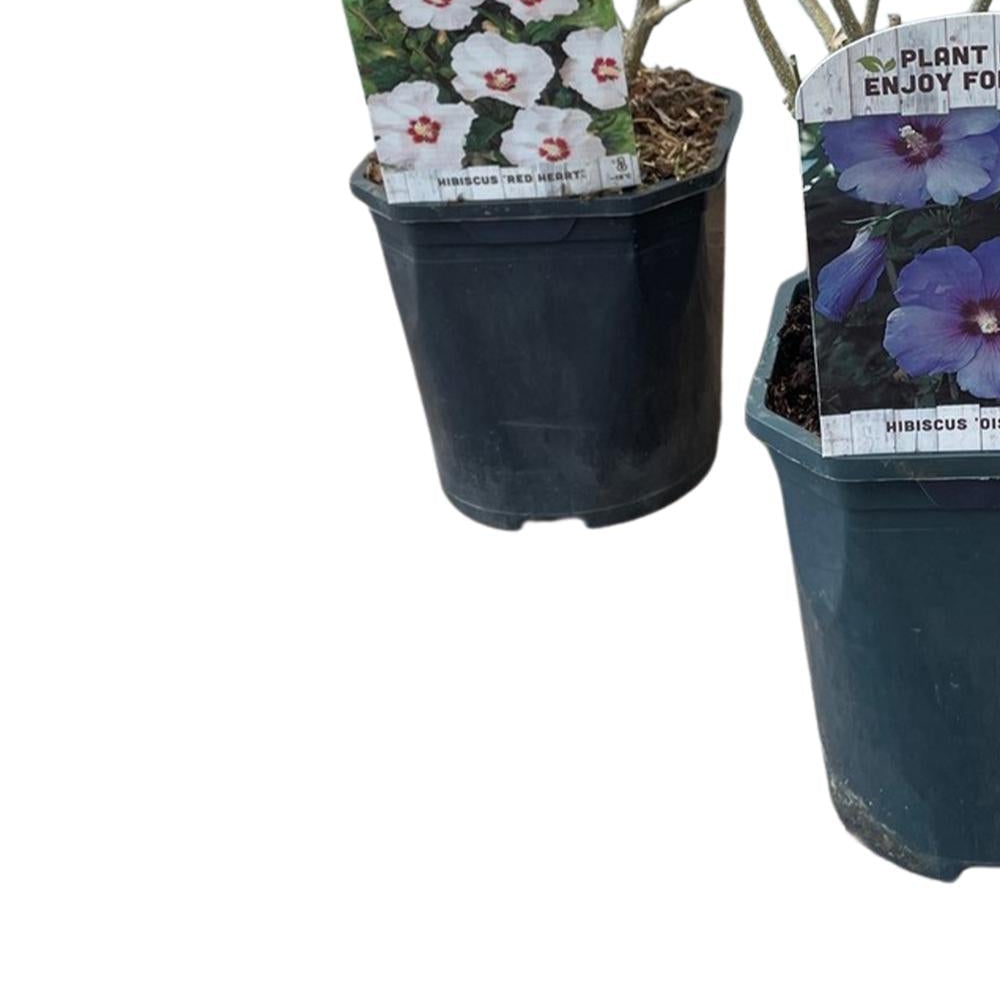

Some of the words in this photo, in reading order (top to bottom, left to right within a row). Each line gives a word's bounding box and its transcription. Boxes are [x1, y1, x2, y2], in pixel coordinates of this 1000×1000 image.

[901, 45, 989, 68] PLANT
[864, 73, 953, 96] ENJOY
[437, 175, 499, 187] HIBISCUS
[886, 417, 968, 432] HIBISCUS
